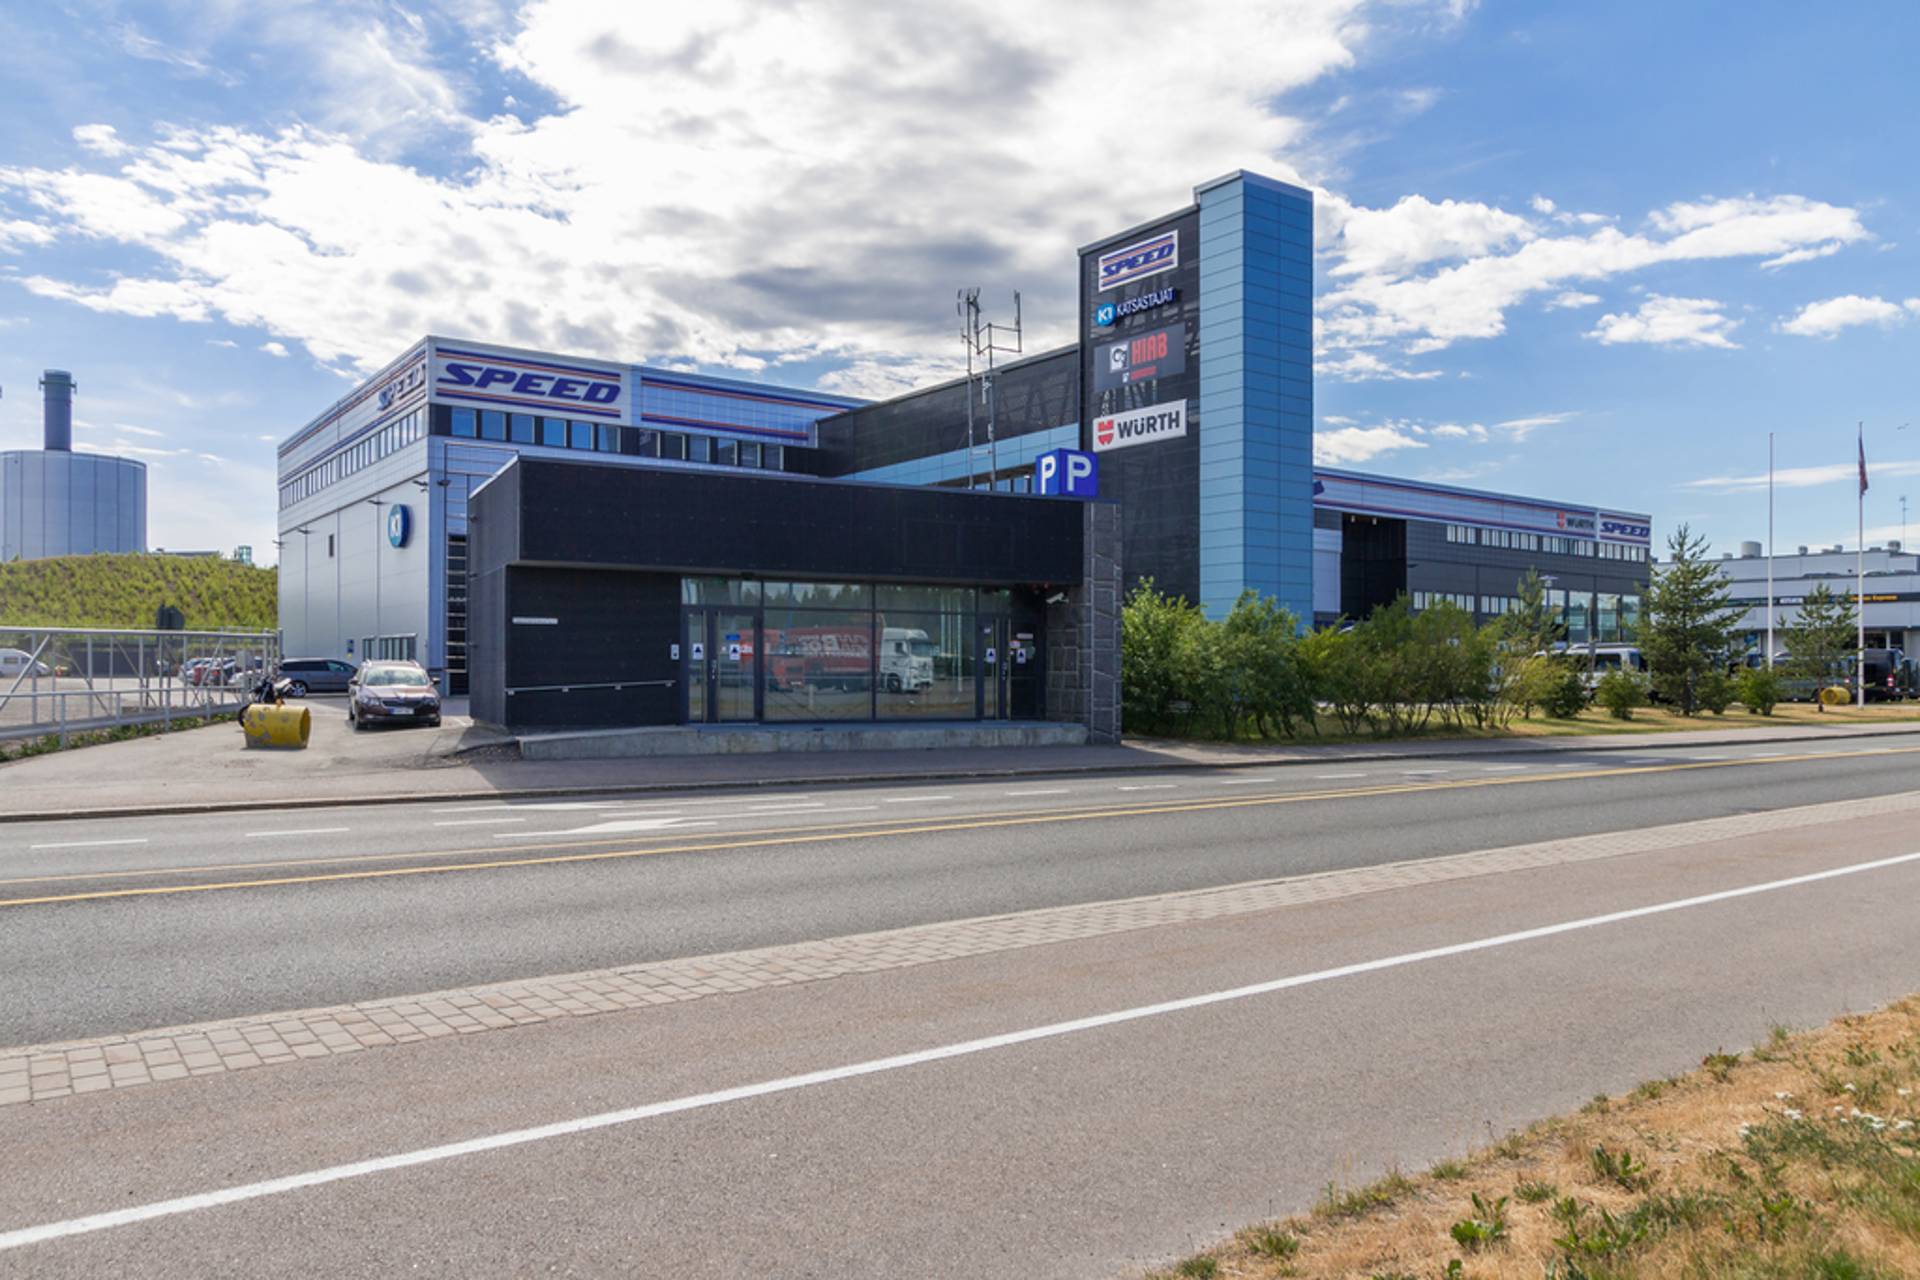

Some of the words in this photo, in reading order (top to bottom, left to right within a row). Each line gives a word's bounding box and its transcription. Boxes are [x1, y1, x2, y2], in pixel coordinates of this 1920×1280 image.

[1101, 242, 1175, 280] SPEED
[1116, 287, 1174, 316] KATSASTAJAT
[1131, 332, 1168, 365] HIAB
[436, 362, 622, 405] SPEED
[1117, 410, 1180, 439] WÜRTH
[1041, 455, 1057, 495] P
[1067, 454, 1092, 492] P
[1600, 520, 1650, 538] SPEED
